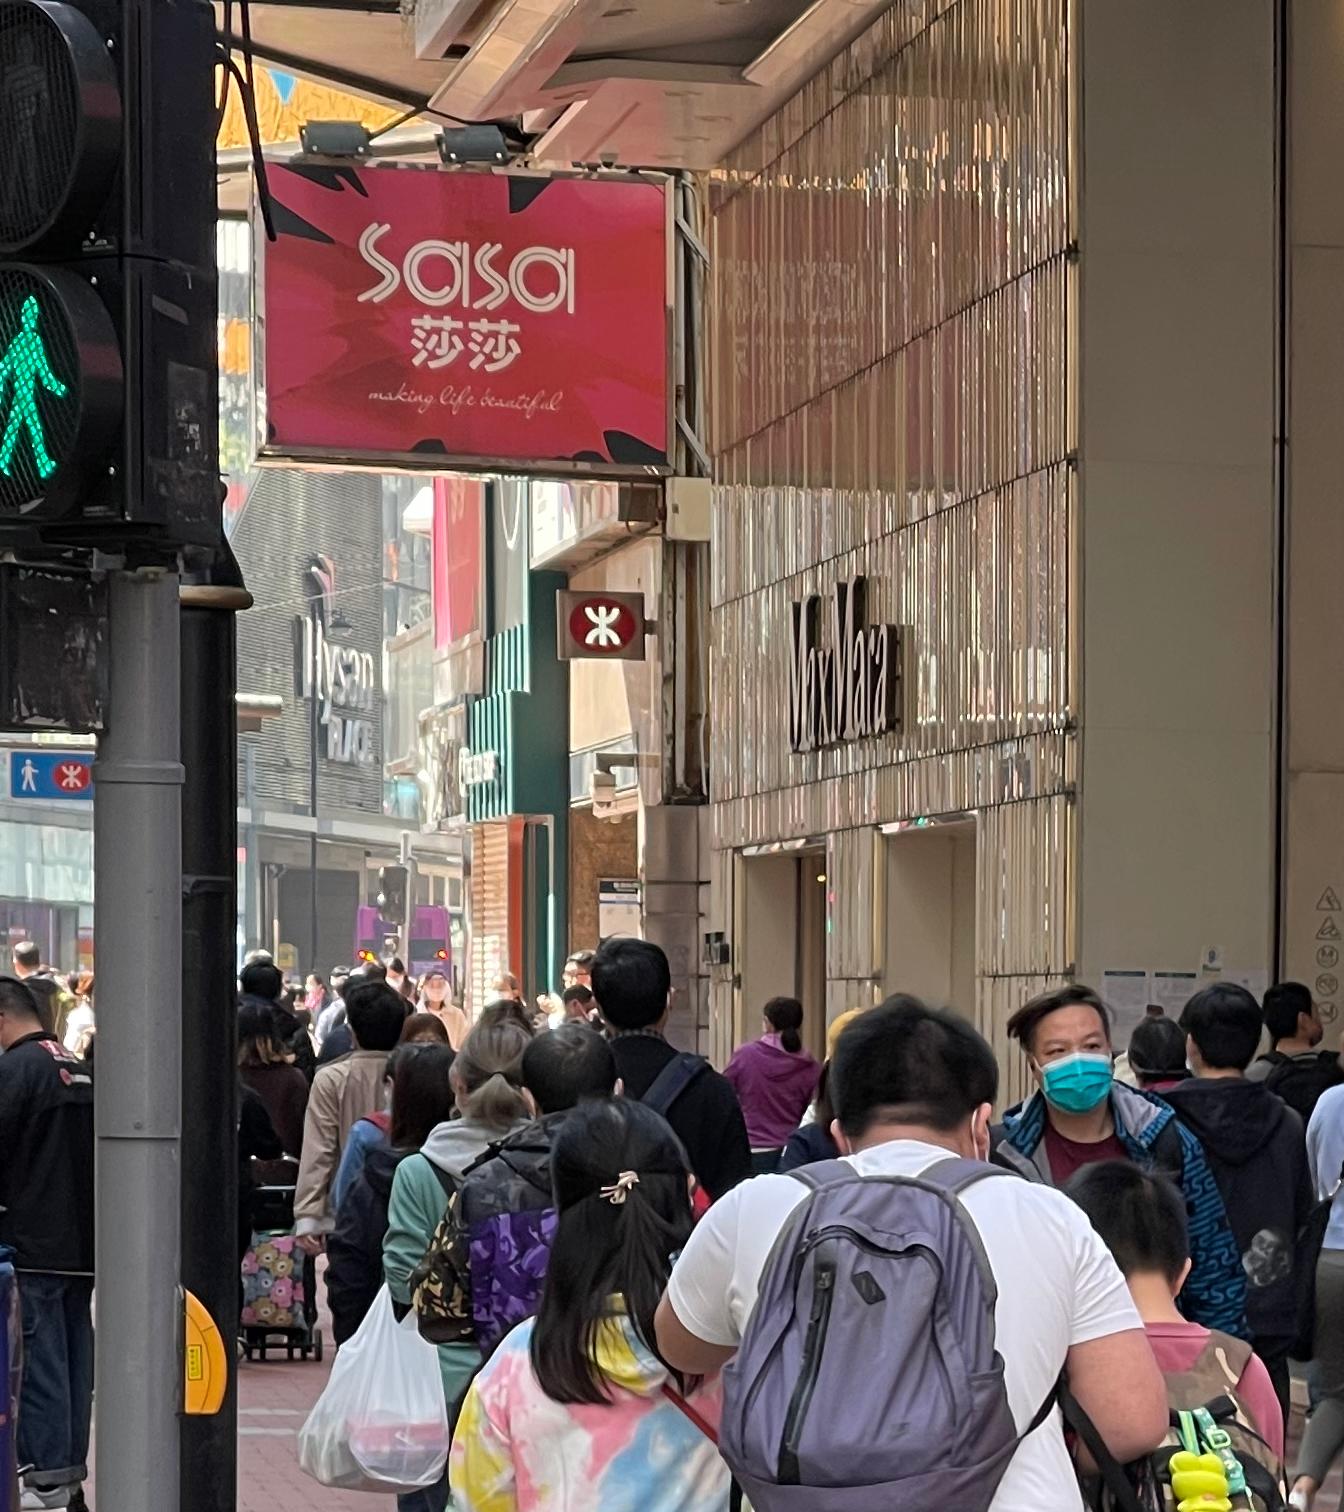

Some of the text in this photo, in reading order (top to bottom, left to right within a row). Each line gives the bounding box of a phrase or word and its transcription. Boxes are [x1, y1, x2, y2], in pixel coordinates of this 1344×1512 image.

[410, 313, 522, 372] 莎莎
[368, 382, 564, 420] making life beautiful
[296, 613, 375, 724] Hysan
